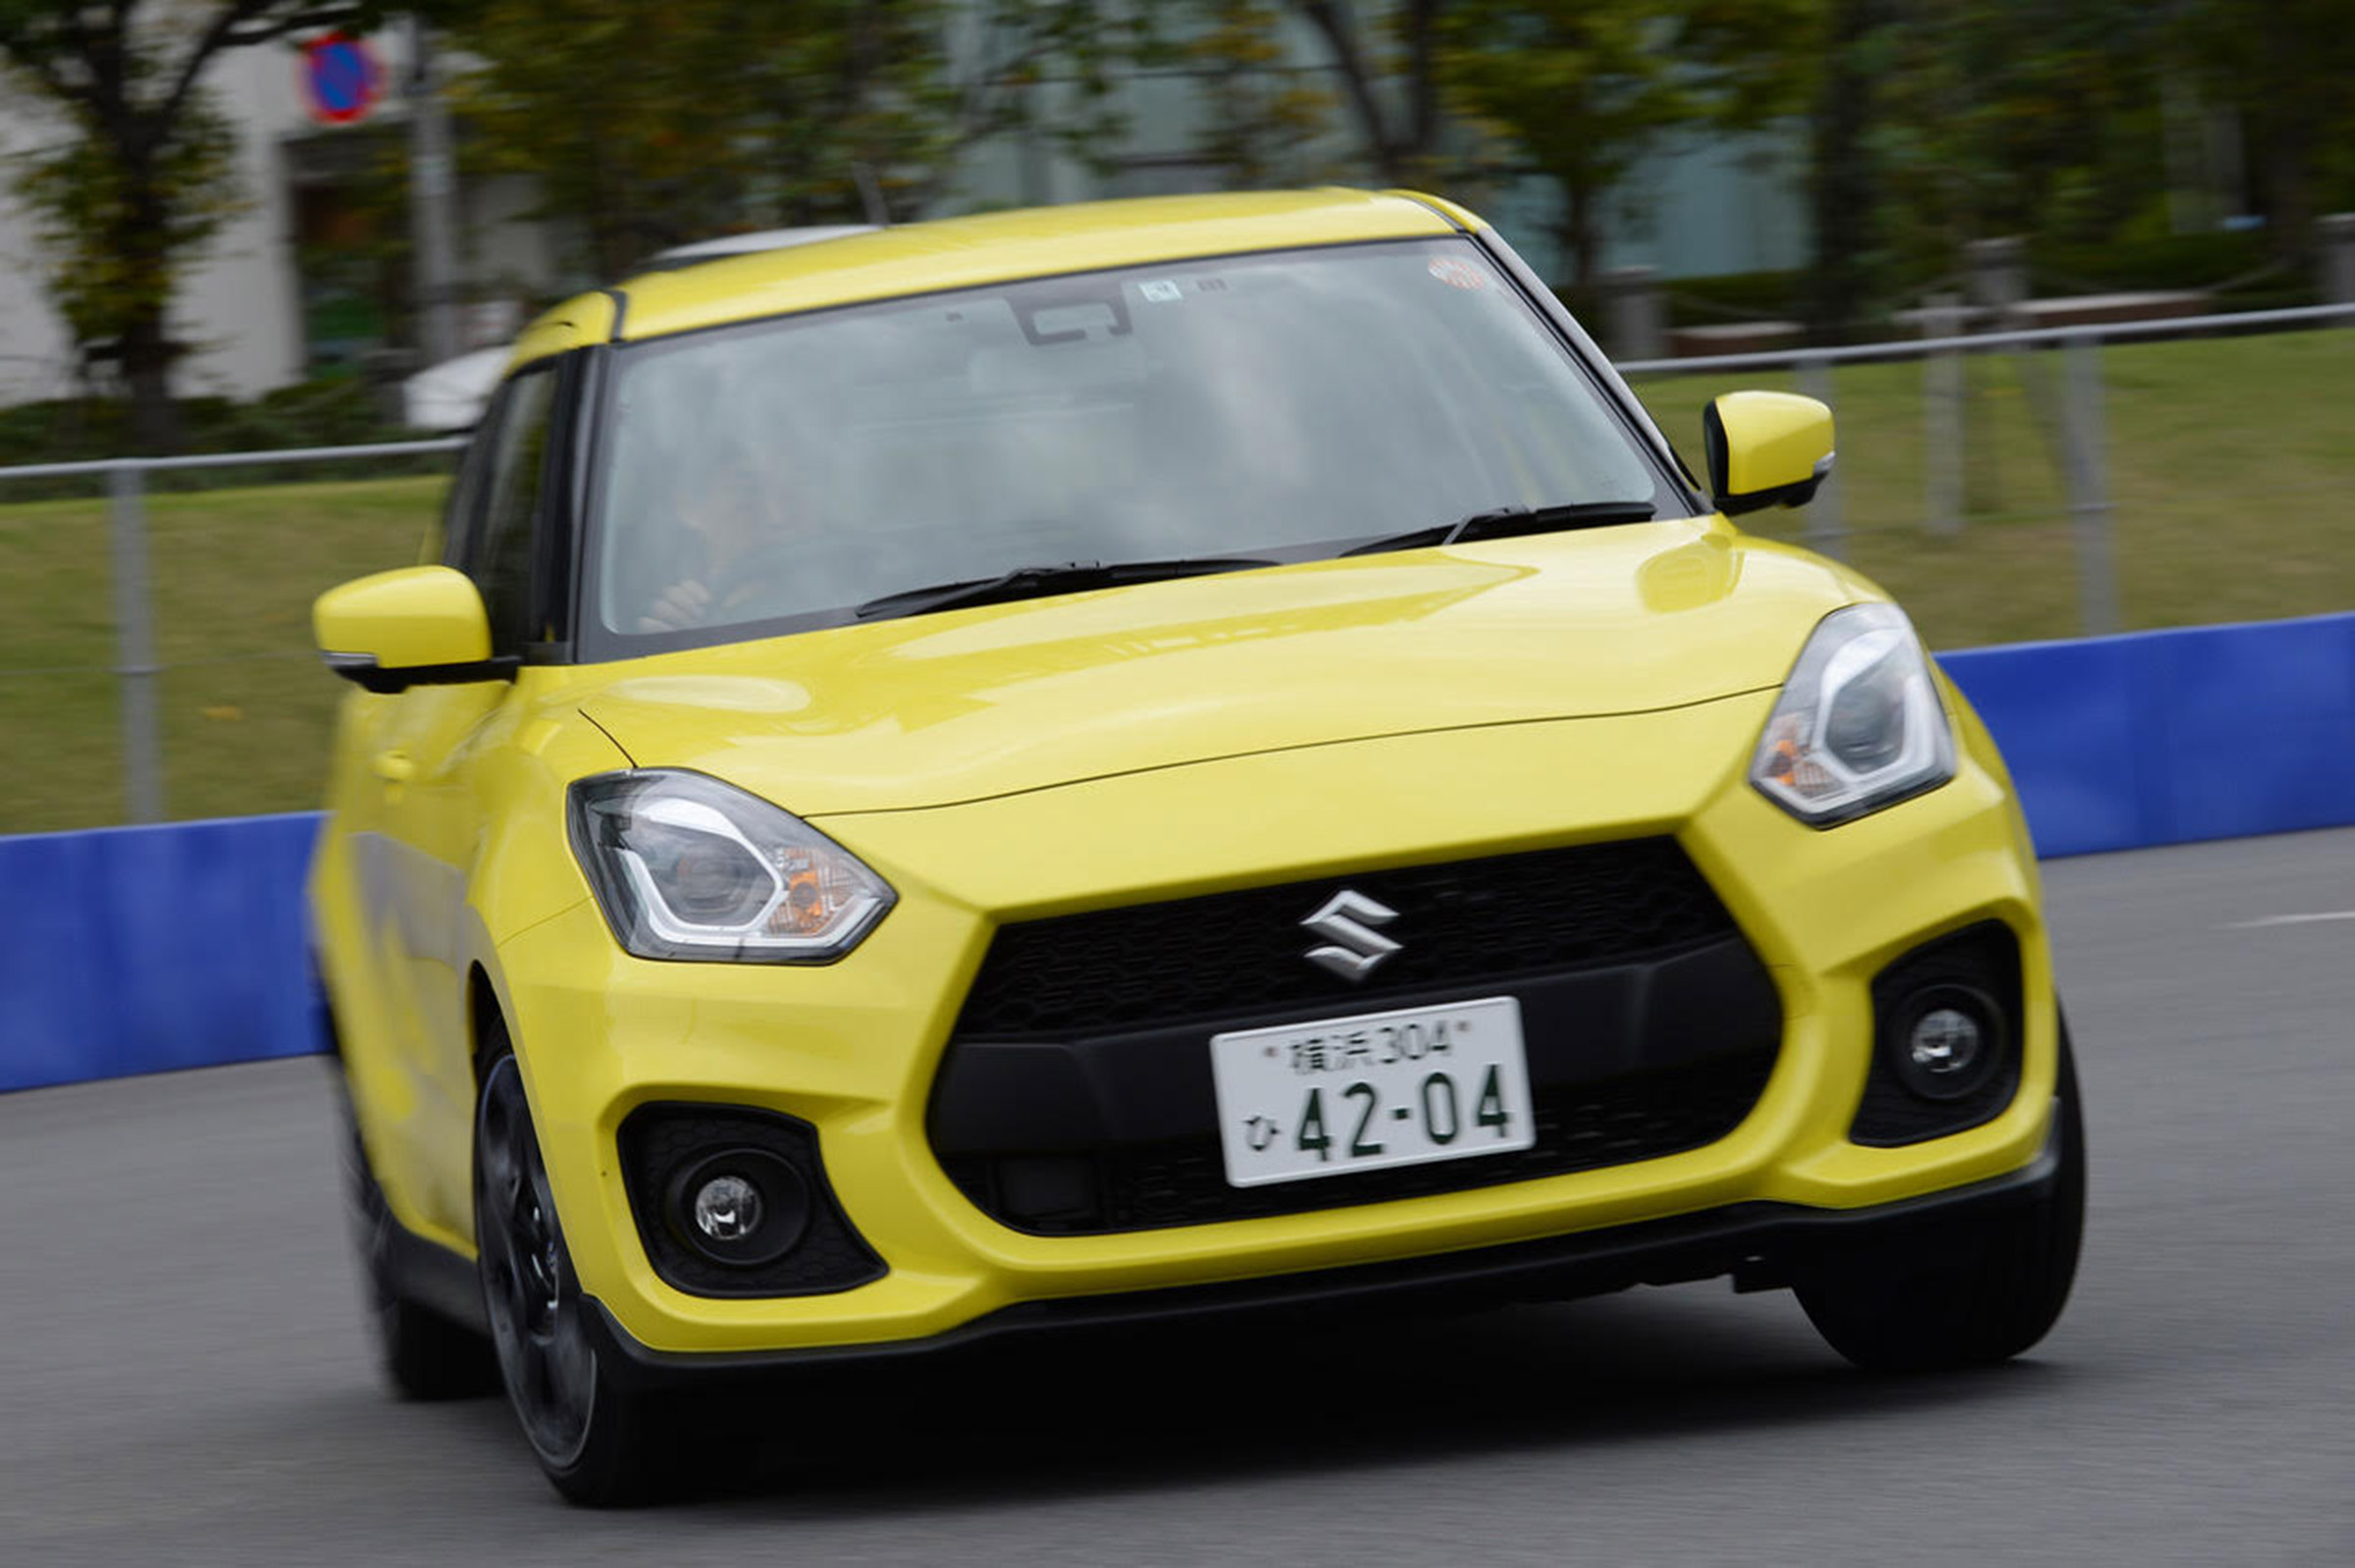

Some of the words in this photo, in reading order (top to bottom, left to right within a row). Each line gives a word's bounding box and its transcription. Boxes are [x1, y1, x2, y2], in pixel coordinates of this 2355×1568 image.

[1379, 1021, 1449, 1064] 304
[1243, 1116, 1280, 1152] ひ
[1296, 1064, 1511, 1162] 42-04
